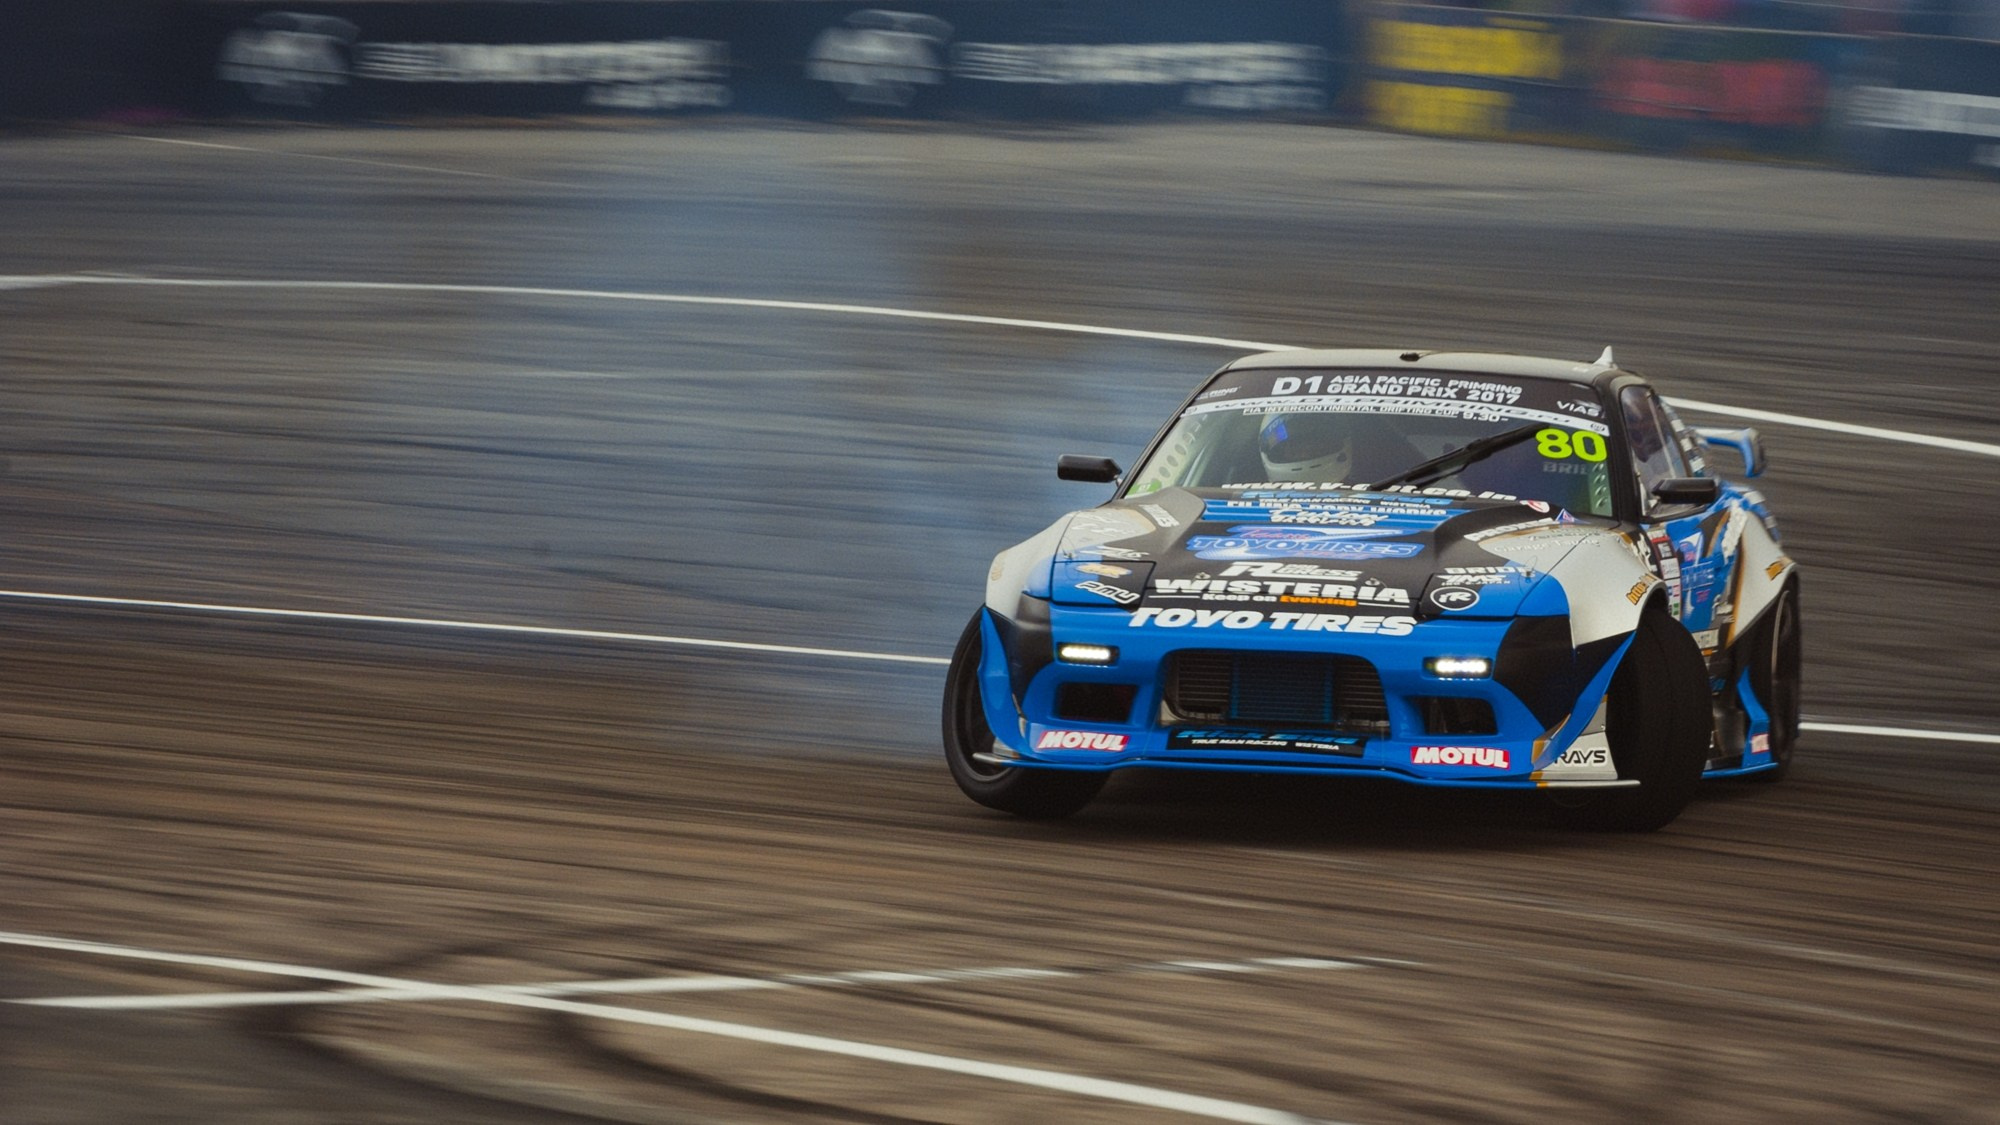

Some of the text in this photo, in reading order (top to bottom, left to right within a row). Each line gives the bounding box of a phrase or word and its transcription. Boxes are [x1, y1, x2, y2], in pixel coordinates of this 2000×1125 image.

[1271, 376, 1323, 396] D1
[1327, 383, 1521, 405] GRAND PRIX 2017
[1330, 375, 1523, 394] ASIA PACIFIC PRIMRING
[1243, 406, 1262, 414] FIA
[1264, 405, 1377, 413] INTERCONTINENTAL
[1381, 406, 1431, 414] DRIFTING
[1435, 409, 1459, 417] CUP
[1536, 428, 1608, 463] 80
[1154, 578, 1410, 604] WISTERIA
[1202, 592, 1251, 603] Keep
[1279, 595, 1358, 607] Evolving
[1128, 607, 1419, 636] TOYO TIRES
[1038, 731, 1128, 752] MOTUL
[1295, 742, 1339, 750] WISTERIA
[1413, 747, 1509, 769] MOTUL
[1555, 750, 1606, 764] RAYS
